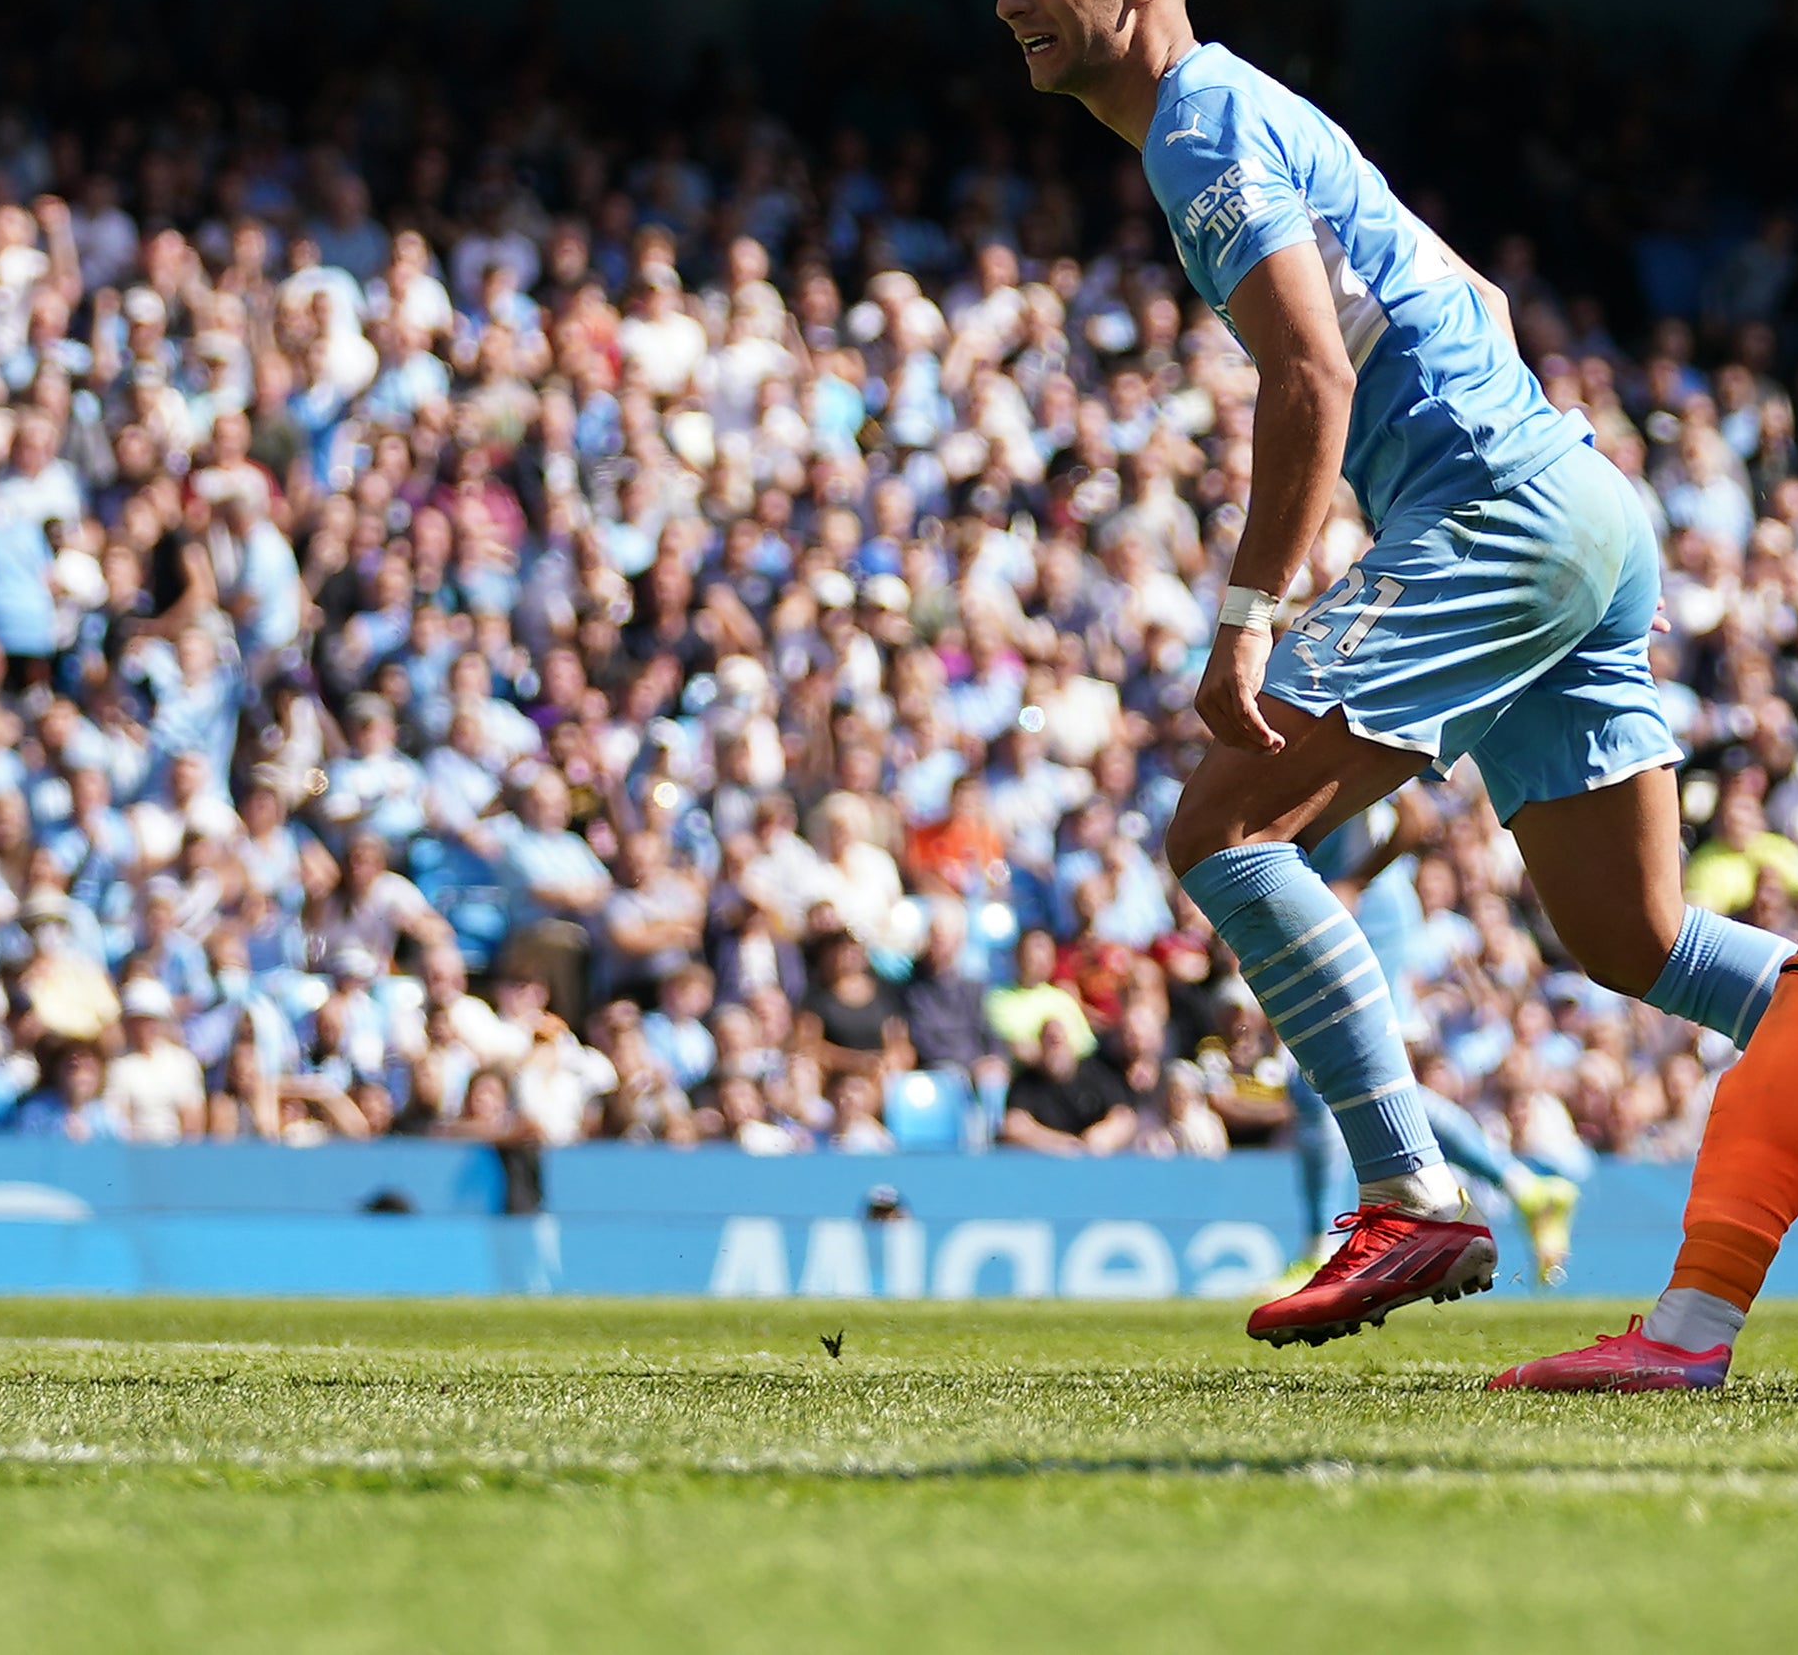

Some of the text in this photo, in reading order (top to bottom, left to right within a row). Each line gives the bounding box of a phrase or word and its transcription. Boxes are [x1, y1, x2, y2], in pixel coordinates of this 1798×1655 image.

[1184, 156, 1268, 239] NEXEN
[1204, 185, 1269, 241] TIRE
[1287, 565, 1407, 660] 21
